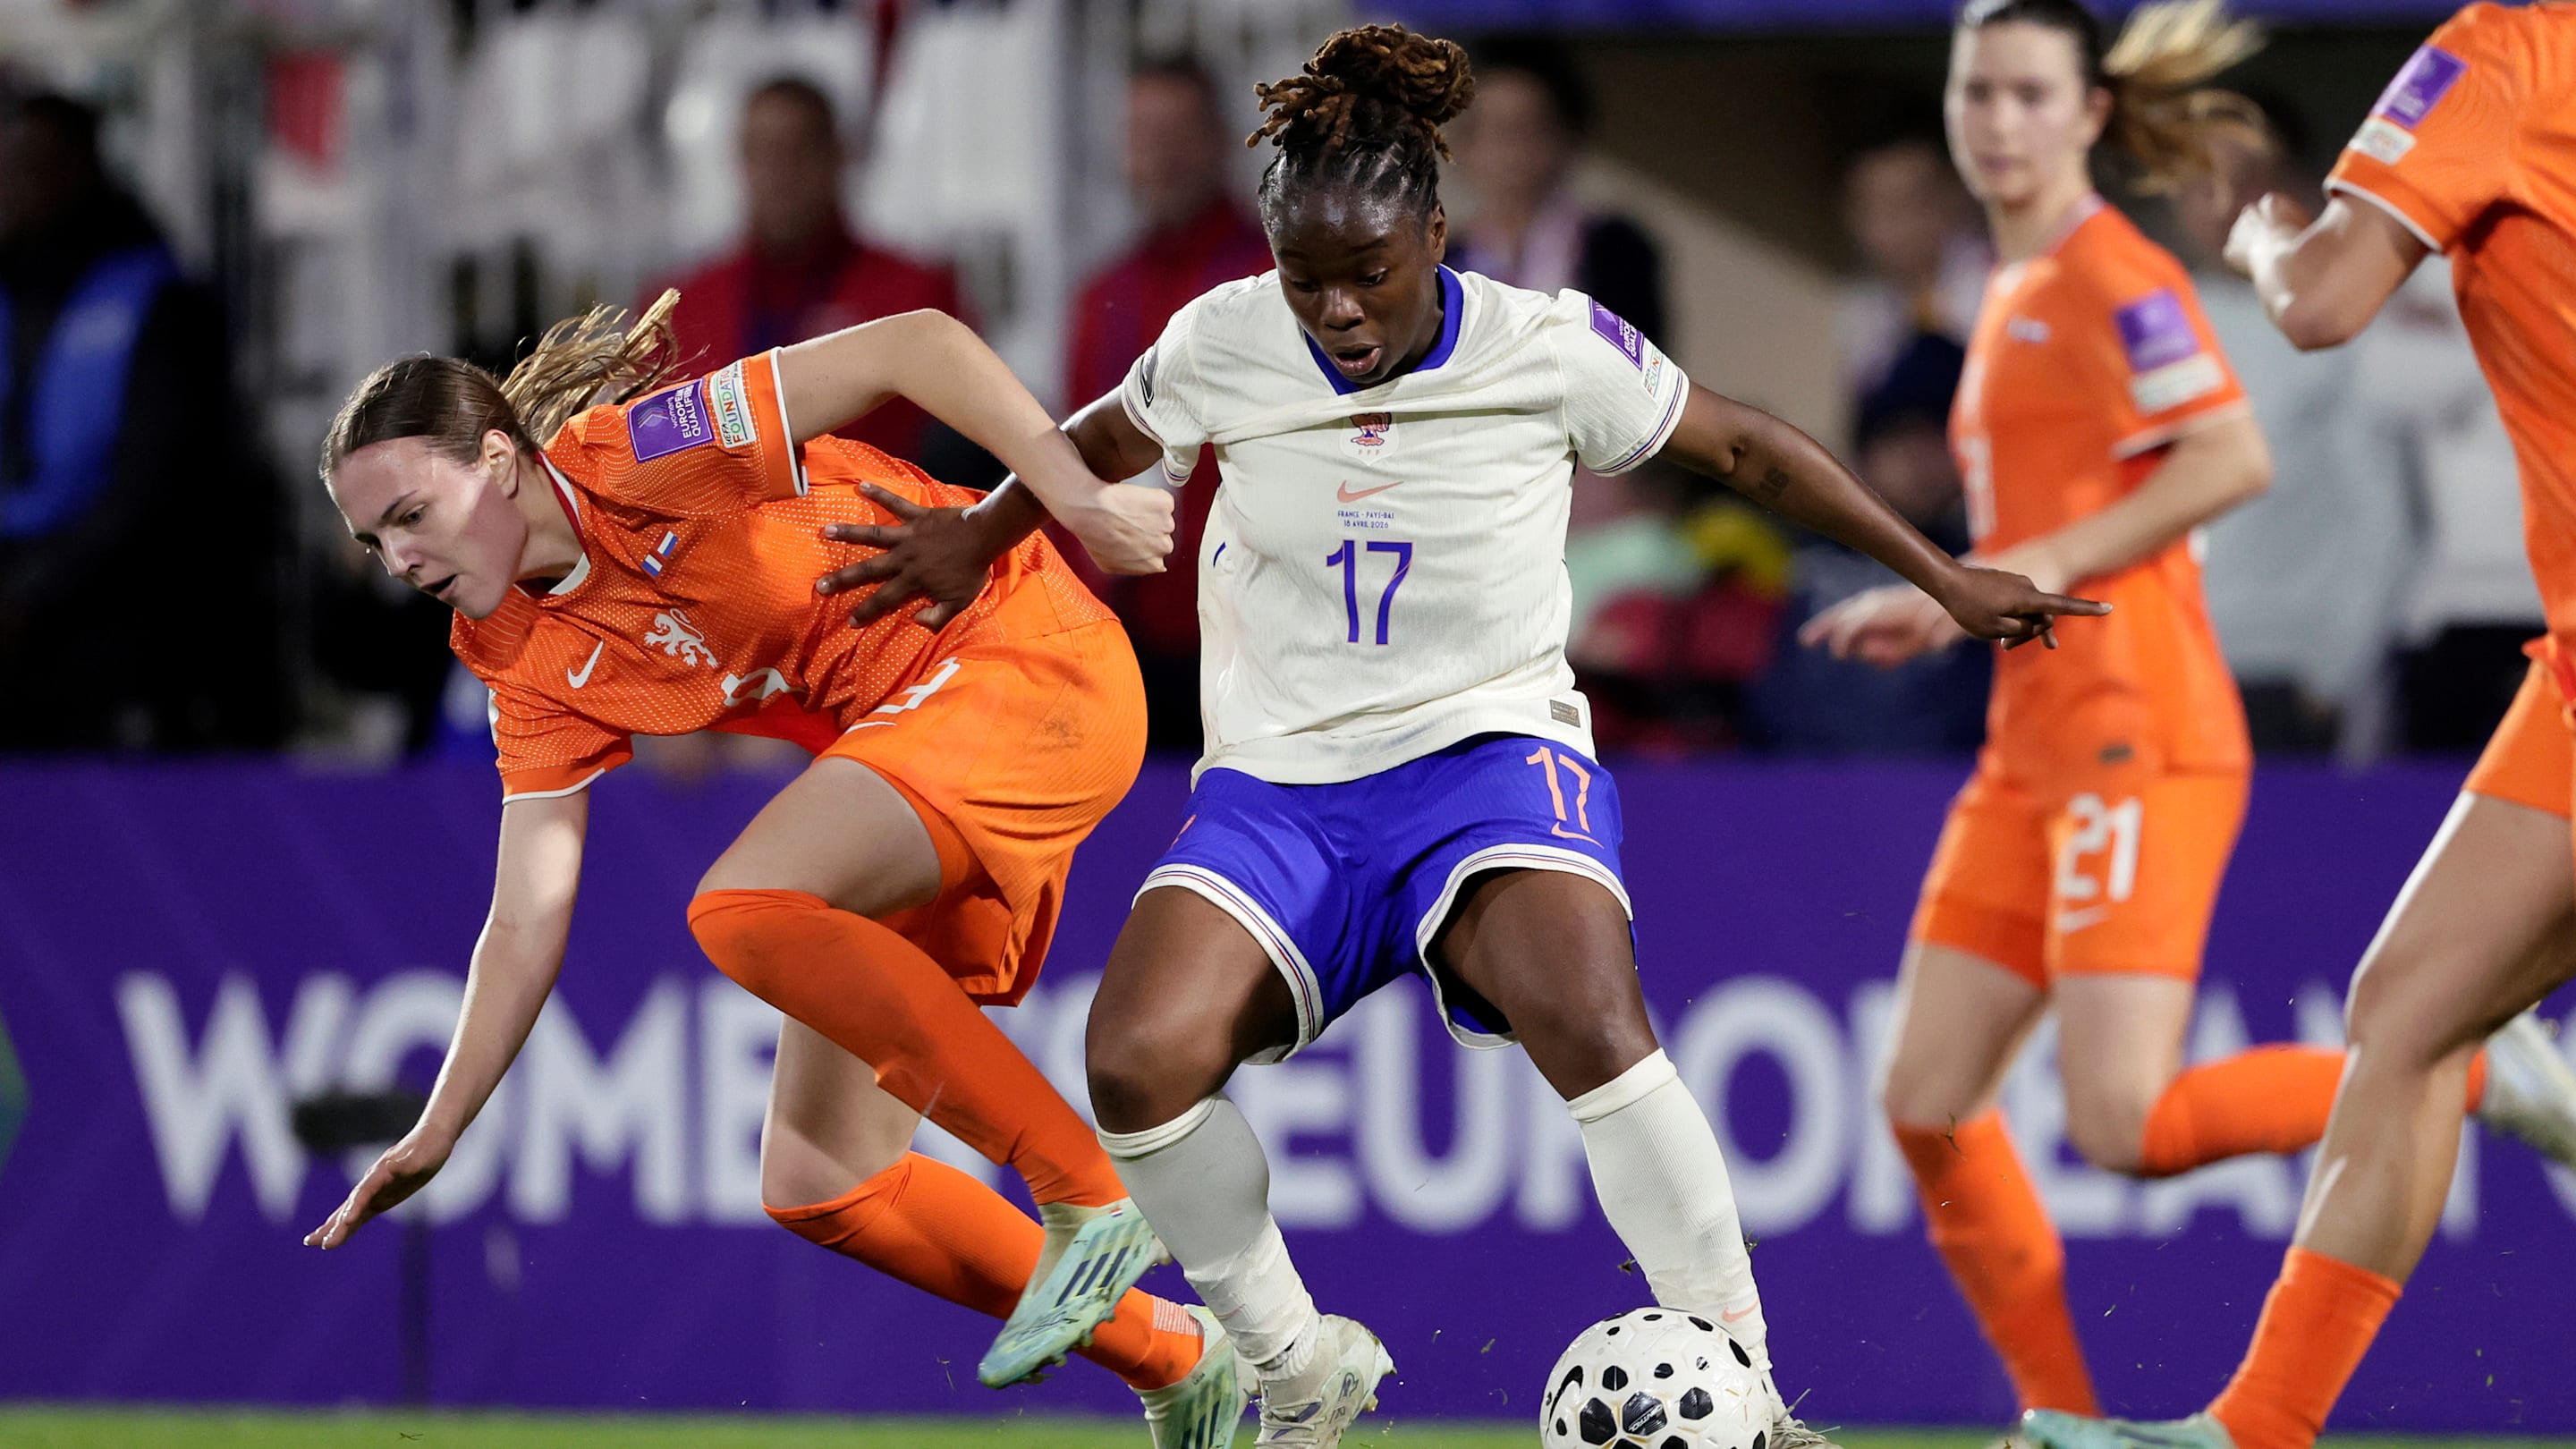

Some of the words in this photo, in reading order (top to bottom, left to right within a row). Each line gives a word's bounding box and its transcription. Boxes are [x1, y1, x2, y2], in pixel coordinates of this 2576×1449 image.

[720, 369, 743, 444] FOUNDATIO
[1337, 510, 1360, 518] FRANCE
[1370, 521, 1389, 529] 2026
[1326, 539, 1413, 645] 17
[1526, 746, 1591, 833] 17
[2055, 792, 2145, 903] 21
